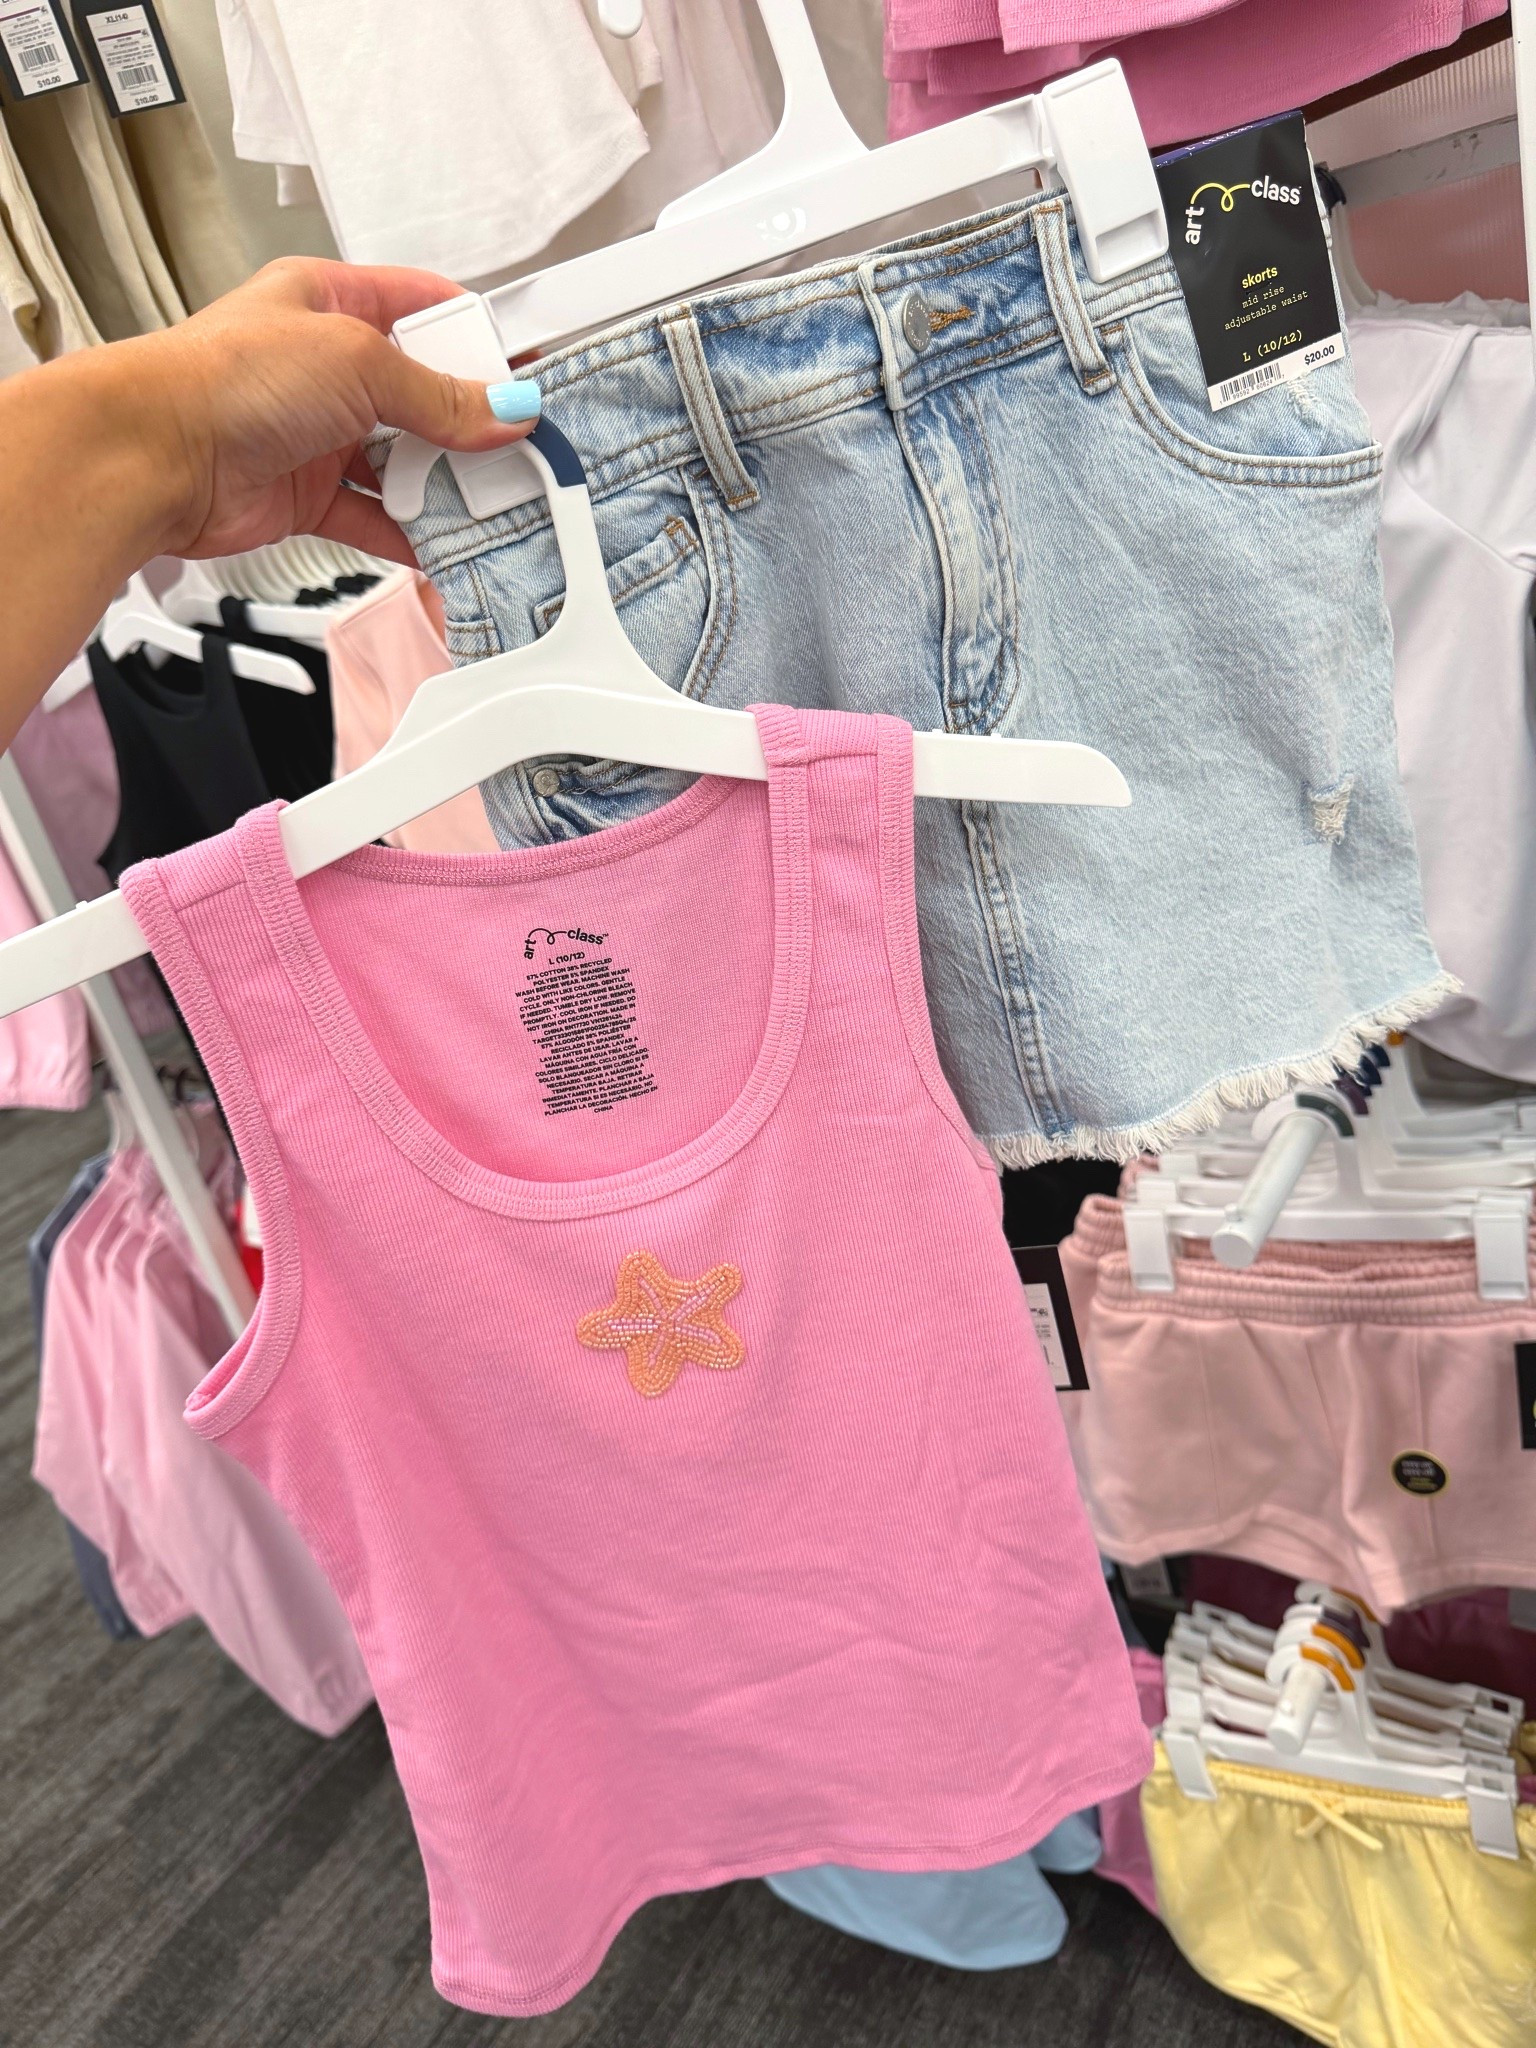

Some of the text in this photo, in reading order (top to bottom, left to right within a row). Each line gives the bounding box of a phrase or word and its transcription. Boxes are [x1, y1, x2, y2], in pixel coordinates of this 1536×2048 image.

[37, 75, 61, 88] $10.00
[134, 94, 159, 106] $10.00
[1185, 206, 1205, 245] art
[1241, 266, 1278, 289] skorts
[1242, 286, 1285, 309] mid rise
[1224, 290, 1309, 331] adjustable waist
[1243, 329, 1303, 363] L (10/12)
[1304, 344, 1336, 366] $20.00
[524, 938, 537, 960] art
[556, 952, 585, 964] (10/12)
[533, 974, 569, 986] POLYESTER
[580, 966, 609, 976] SPANDEX
[539, 968, 566, 977] COTTON
[580, 958, 612, 968] RECYCLED
[515, 968, 630, 997] WASH BEFORE WEAR. MACHINE WASH
[523, 995, 541, 1003] COLD
[574, 982, 601, 991] COLORS.
[601, 976, 625, 985] GENTLE
[519, 982, 633, 1012] CYCLE. ONLY NON-CHLORINE BLEACH
[527, 1007, 553, 1017] NEEDED.
[554, 1001, 579, 1011] TUMBLE
[610, 988, 636, 998] REMOVE
[523, 1013, 559, 1025] PROMPTLY.
[559, 1009, 577, 1017] COOL
[600, 998, 626, 1007] NEEDED.
[541, 1021, 557, 1029] IRON
[568, 1009, 610, 1022] DECORATION.
[544, 1027, 564, 1035] CHINA
[554, 1035, 585, 1046] ALGODÓN
[598, 1024, 631, 1036] POLIÉSTER
[540, 1054, 561, 1063] LAVAR
[562, 1050, 583, 1058] ANTES
[593, 1043, 611, 1051] USAR.
[612, 1038, 633, 1046] LAVAR
[551, 1043, 586, 1054] RECICLADO
[596, 1033, 625, 1044] SPANDEX
[535, 1048, 650, 1078] COLORES SIMILARES. CICLO DELICADO.
[545, 1057, 575, 1068] MÁQUINA
[590, 1051, 608, 1059] AGUA
[608, 1046, 622, 1055] FRÍA
[547, 1078, 582, 1089] NECESARIO.
[583, 1073, 604, 1081] SECAR
[610, 1064, 639, 1075] MÁQUINA
[556, 1067, 602, 1080] BLANQUEADOR
[614, 1059, 634, 1067] CLORO
[552, 1070, 643, 1094] TEMPERATURA BAJA. RETIRAR
[599, 1080, 632, 1091] PLANCHAR
[638, 1073, 655, 1081] BAJA
[545, 1105, 578, 1116] PLANCHAR
[629, 1089, 650, 1098] HECHO
[548, 1096, 592, 1109] TEMPERATURA
[608, 1084, 643, 1096] NECESARIO.
[594, 1105, 613, 1113] CHINA
